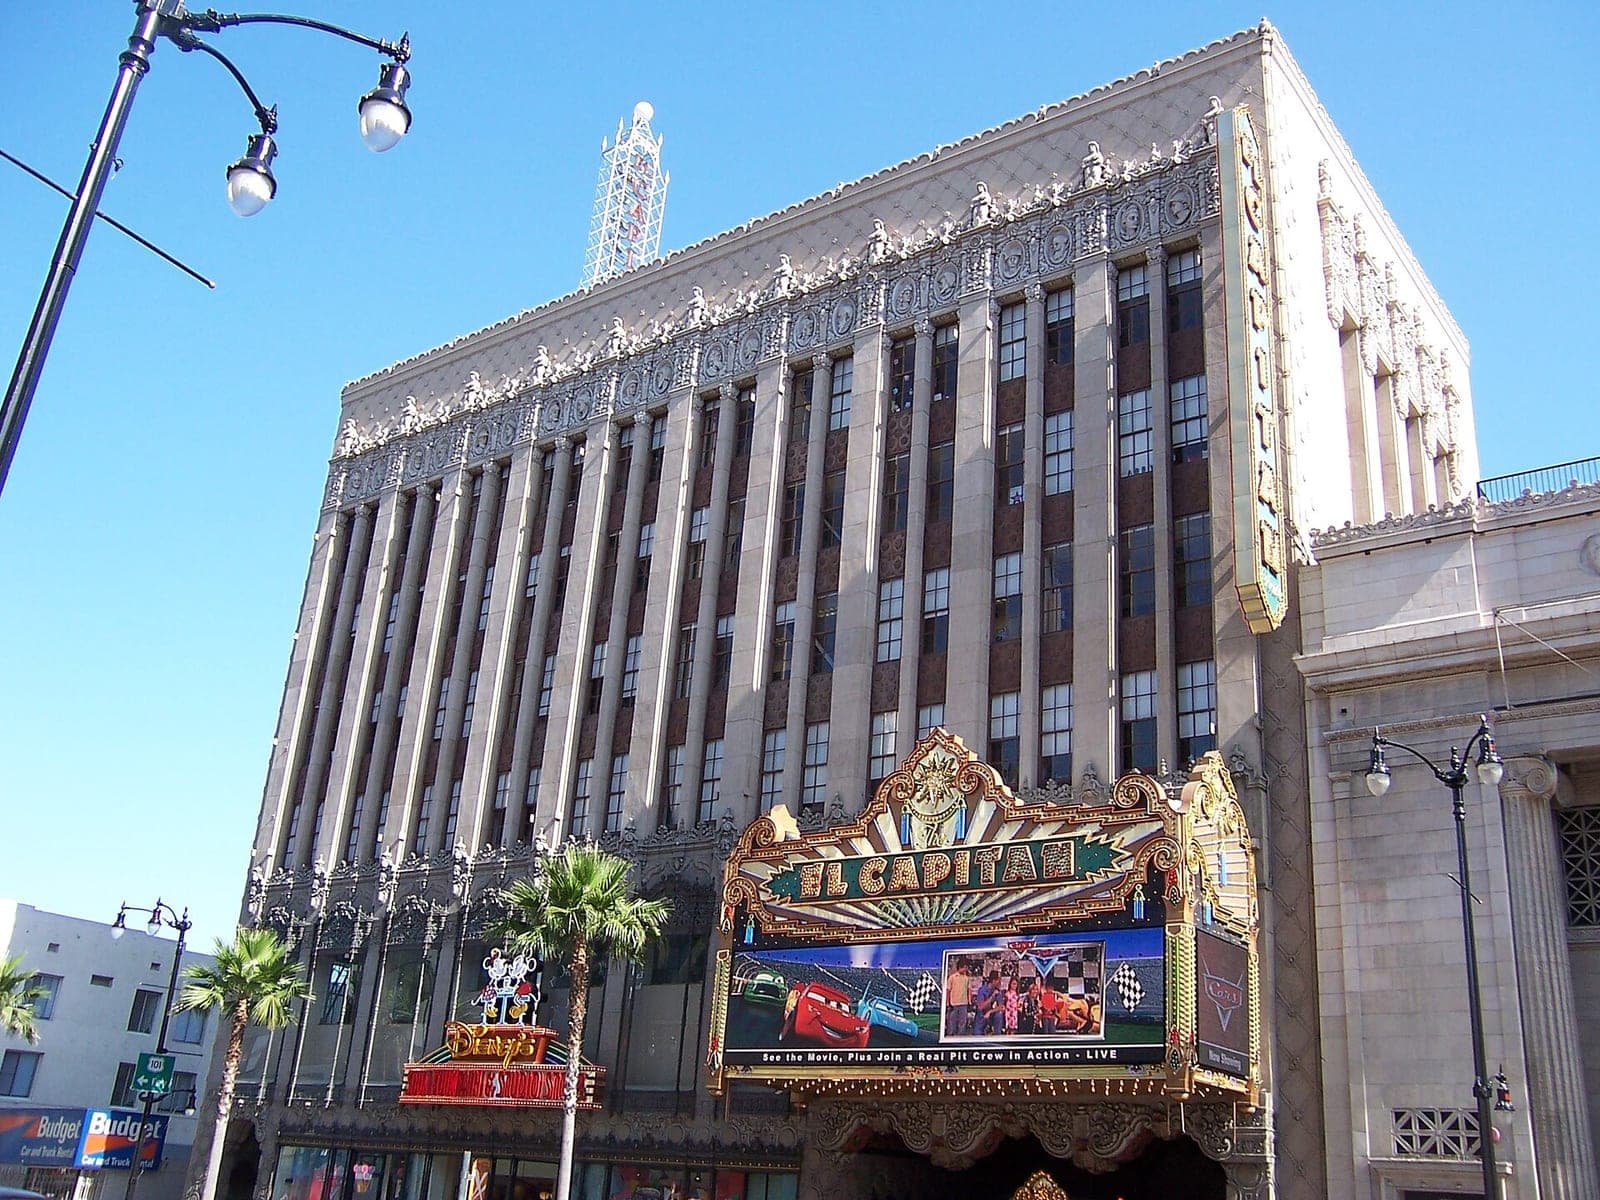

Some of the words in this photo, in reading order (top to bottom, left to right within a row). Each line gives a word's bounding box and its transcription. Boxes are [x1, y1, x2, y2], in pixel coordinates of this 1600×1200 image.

[1244, 185, 1281, 578] CAPITAN
[924, 822, 946, 848] The
[800, 862, 848, 898] EL
[858, 841, 1074, 896] CAPITAN
[151, 1060, 162, 1069] 101
[762, 1053, 782, 1062] See
[786, 1053, 803, 1062] the
[808, 1053, 843, 1063] Movie,
[848, 1052, 872, 1061] Plus
[877, 1052, 901, 1061] Join
[919, 1052, 944, 1061] Real
[950, 1051, 967, 1061] Pit
[972, 1051, 1004, 1060] Crew
[1027, 1050, 1070, 1060] Action
[1086, 1049, 1118, 1059] LIVE
[37, 1116, 81, 1143] Budget
[88, 1111, 161, 1142] Budget
[111, 1157, 131, 1167] Truck
